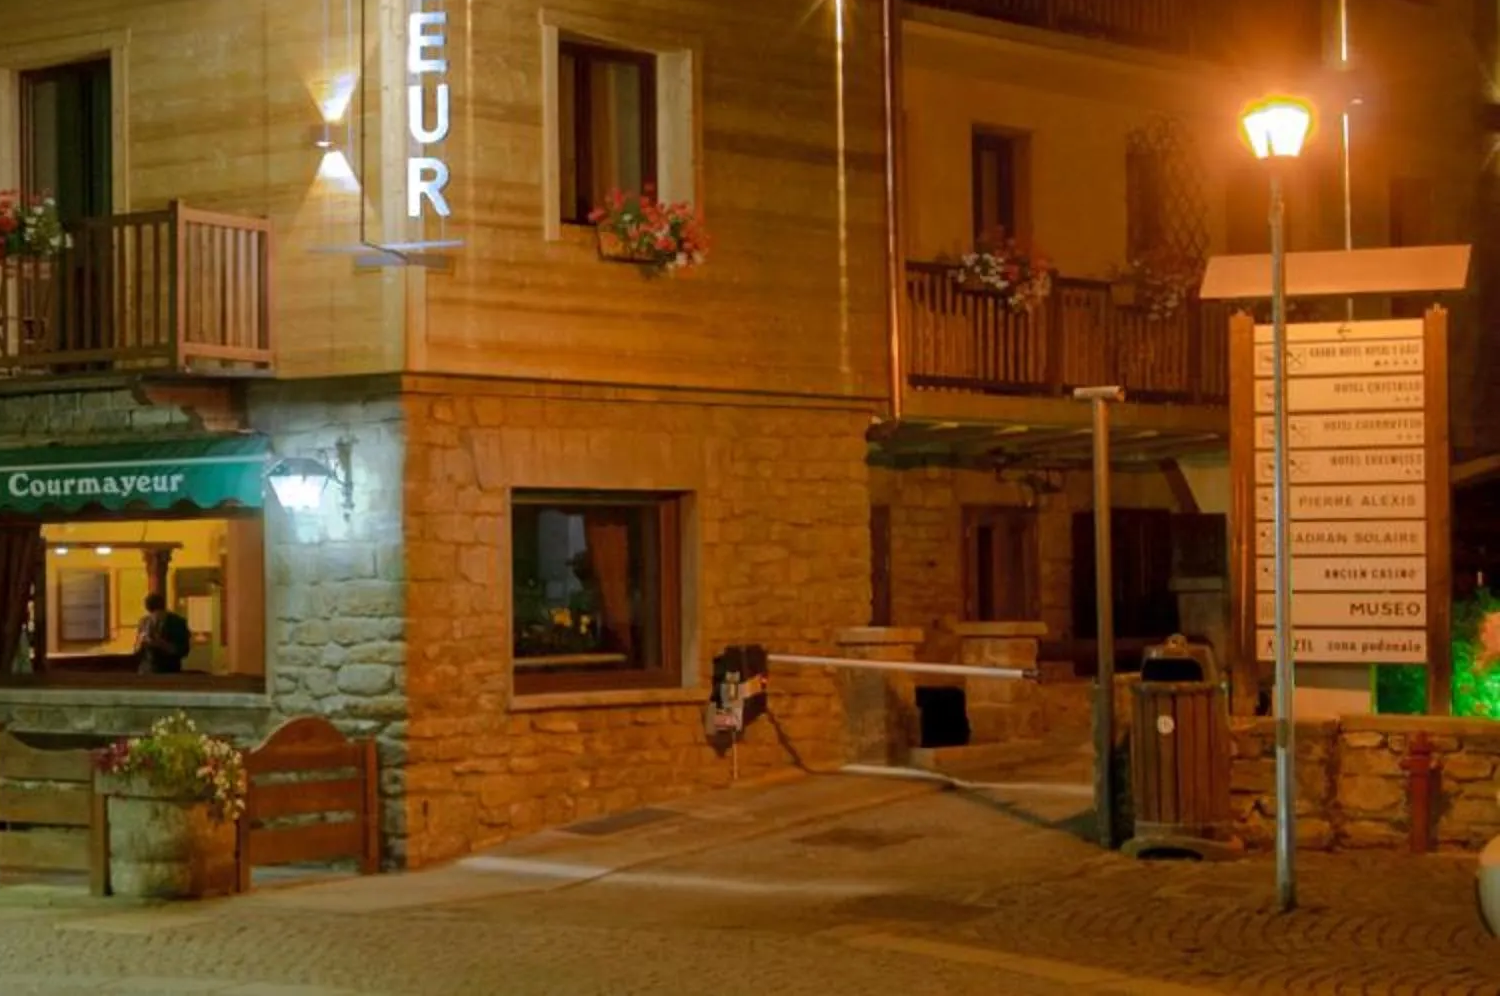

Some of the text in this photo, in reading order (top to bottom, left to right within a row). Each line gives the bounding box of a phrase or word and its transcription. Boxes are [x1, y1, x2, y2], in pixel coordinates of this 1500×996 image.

[8, 473, 185, 497] Courmayeur
[1294, 532, 1348, 544] ADRAN
[1349, 602, 1421, 616] MUSEO
